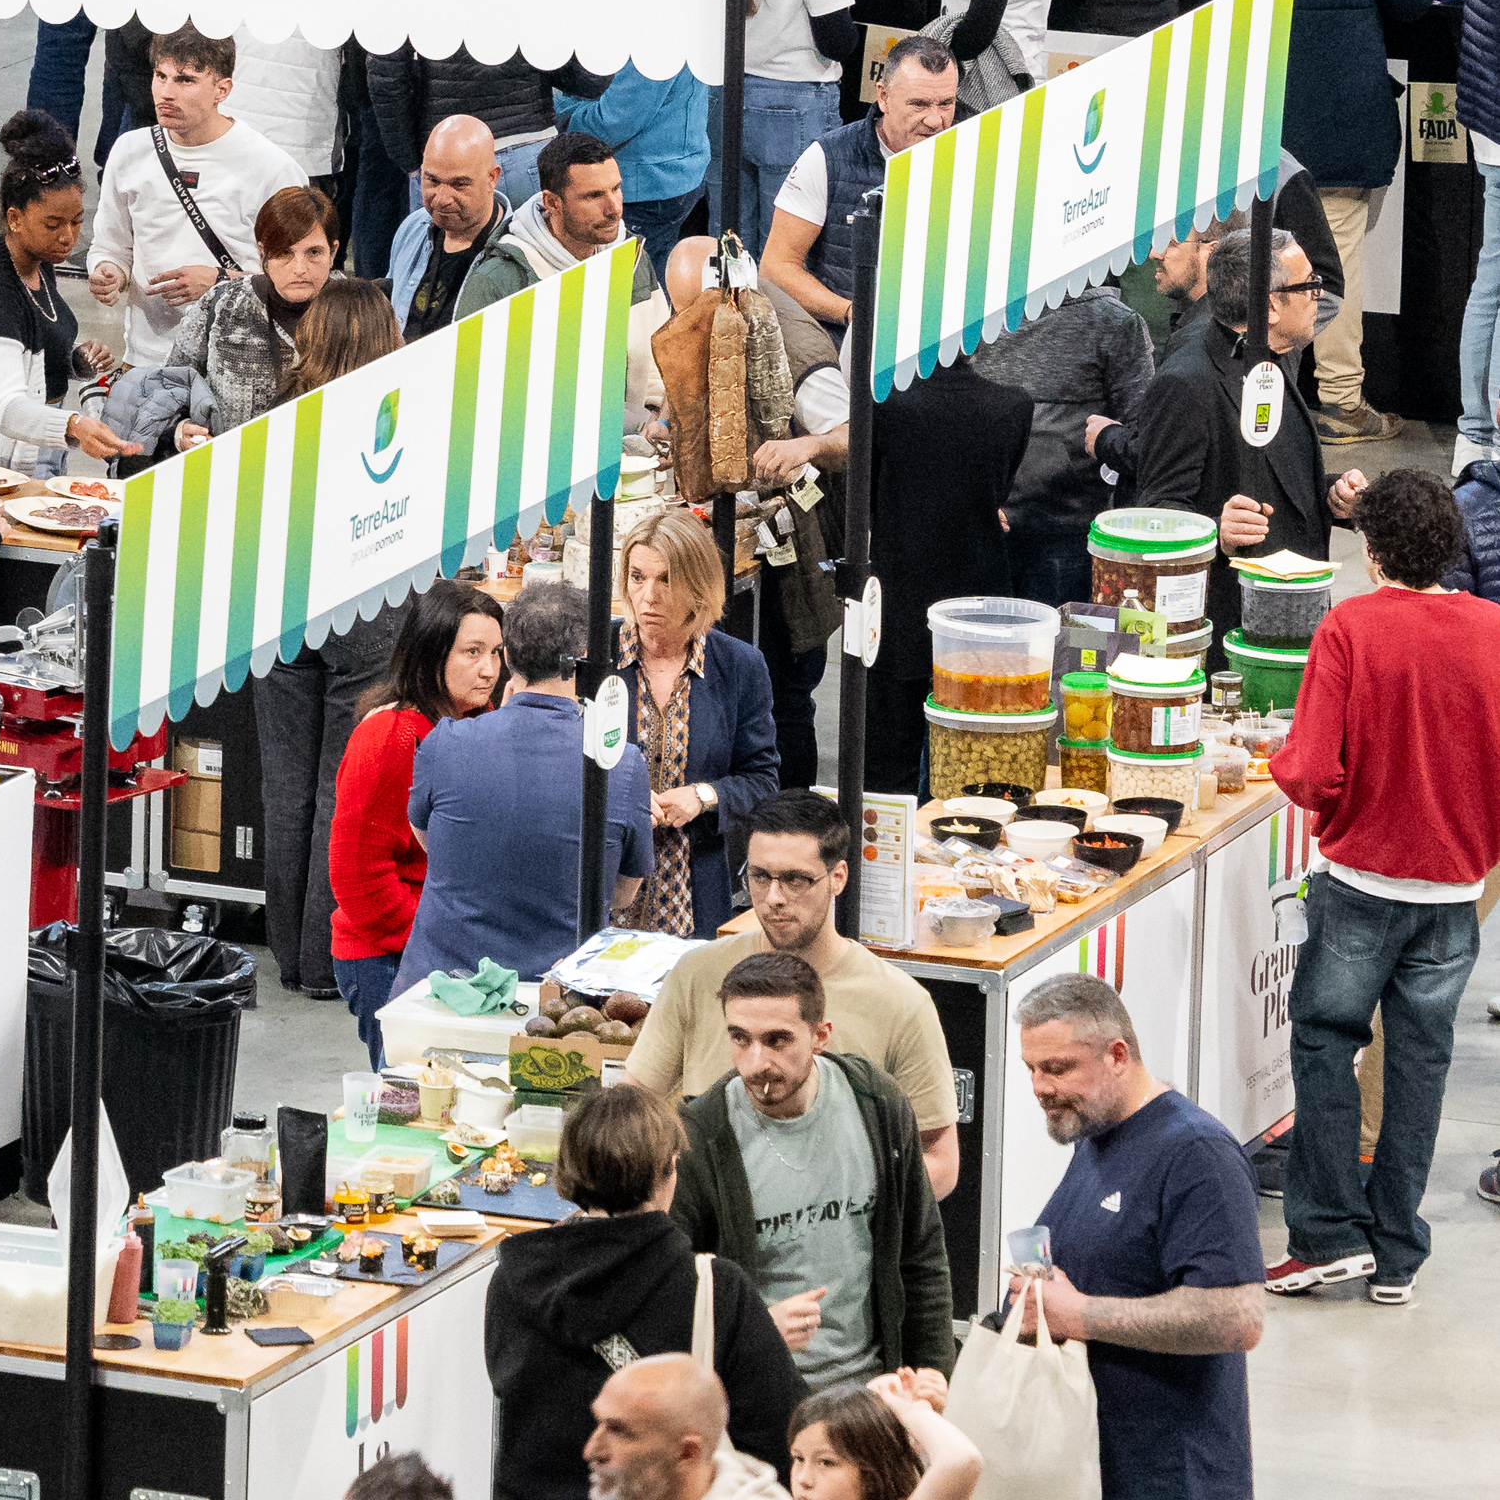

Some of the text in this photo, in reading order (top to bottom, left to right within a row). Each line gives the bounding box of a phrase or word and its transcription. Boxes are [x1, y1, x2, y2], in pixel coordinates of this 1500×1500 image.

[1418, 118, 1459, 141] FADA
[172, 177, 206, 231] CHABRAND
[1062, 185, 1111, 226] TerreAzur
[350, 494, 411, 542] TerreAzur
[374, 529, 404, 553] pomona
[1250, 944, 1298, 997] Gran
